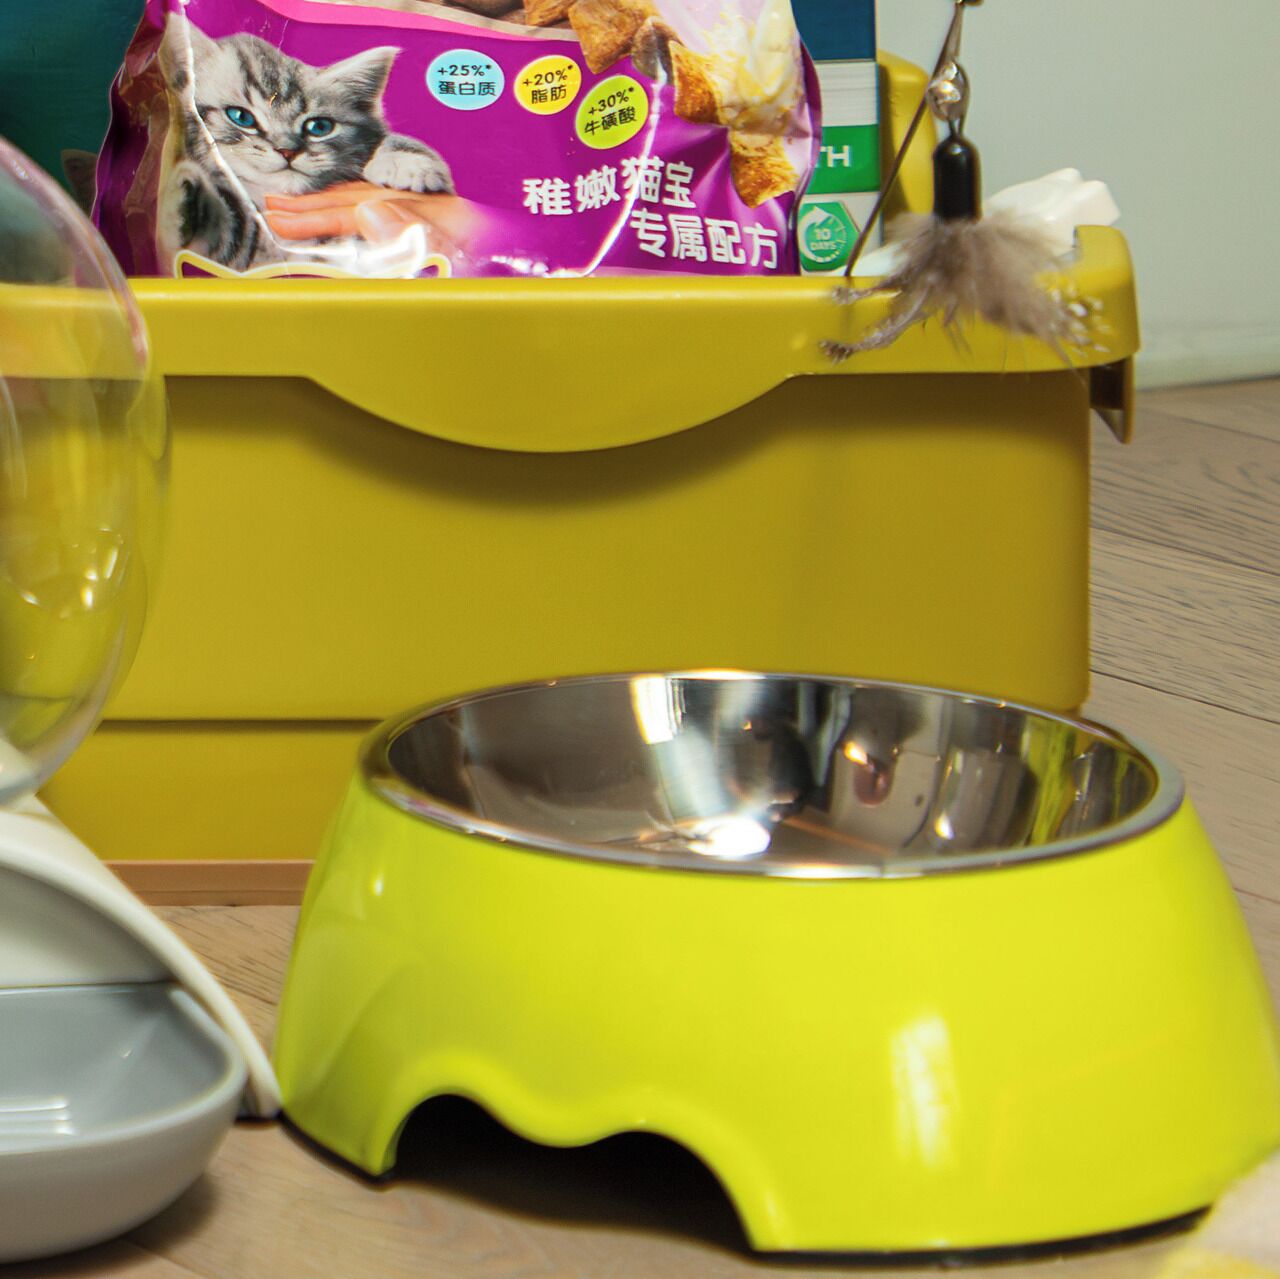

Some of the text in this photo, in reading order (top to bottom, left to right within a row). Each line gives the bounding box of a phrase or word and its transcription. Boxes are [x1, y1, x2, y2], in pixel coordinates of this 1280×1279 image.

[438, 80, 497, 97] 蛋白质
[531, 84, 567, 104] 脂肪
[584, 106, 637, 136] 牛磺酸
[522, 155, 696, 216] 稚嫩猫宝
[629, 207, 778, 269] 专属配方
[814, 228, 831, 240] 10
[810, 240, 837, 251] DAYS
